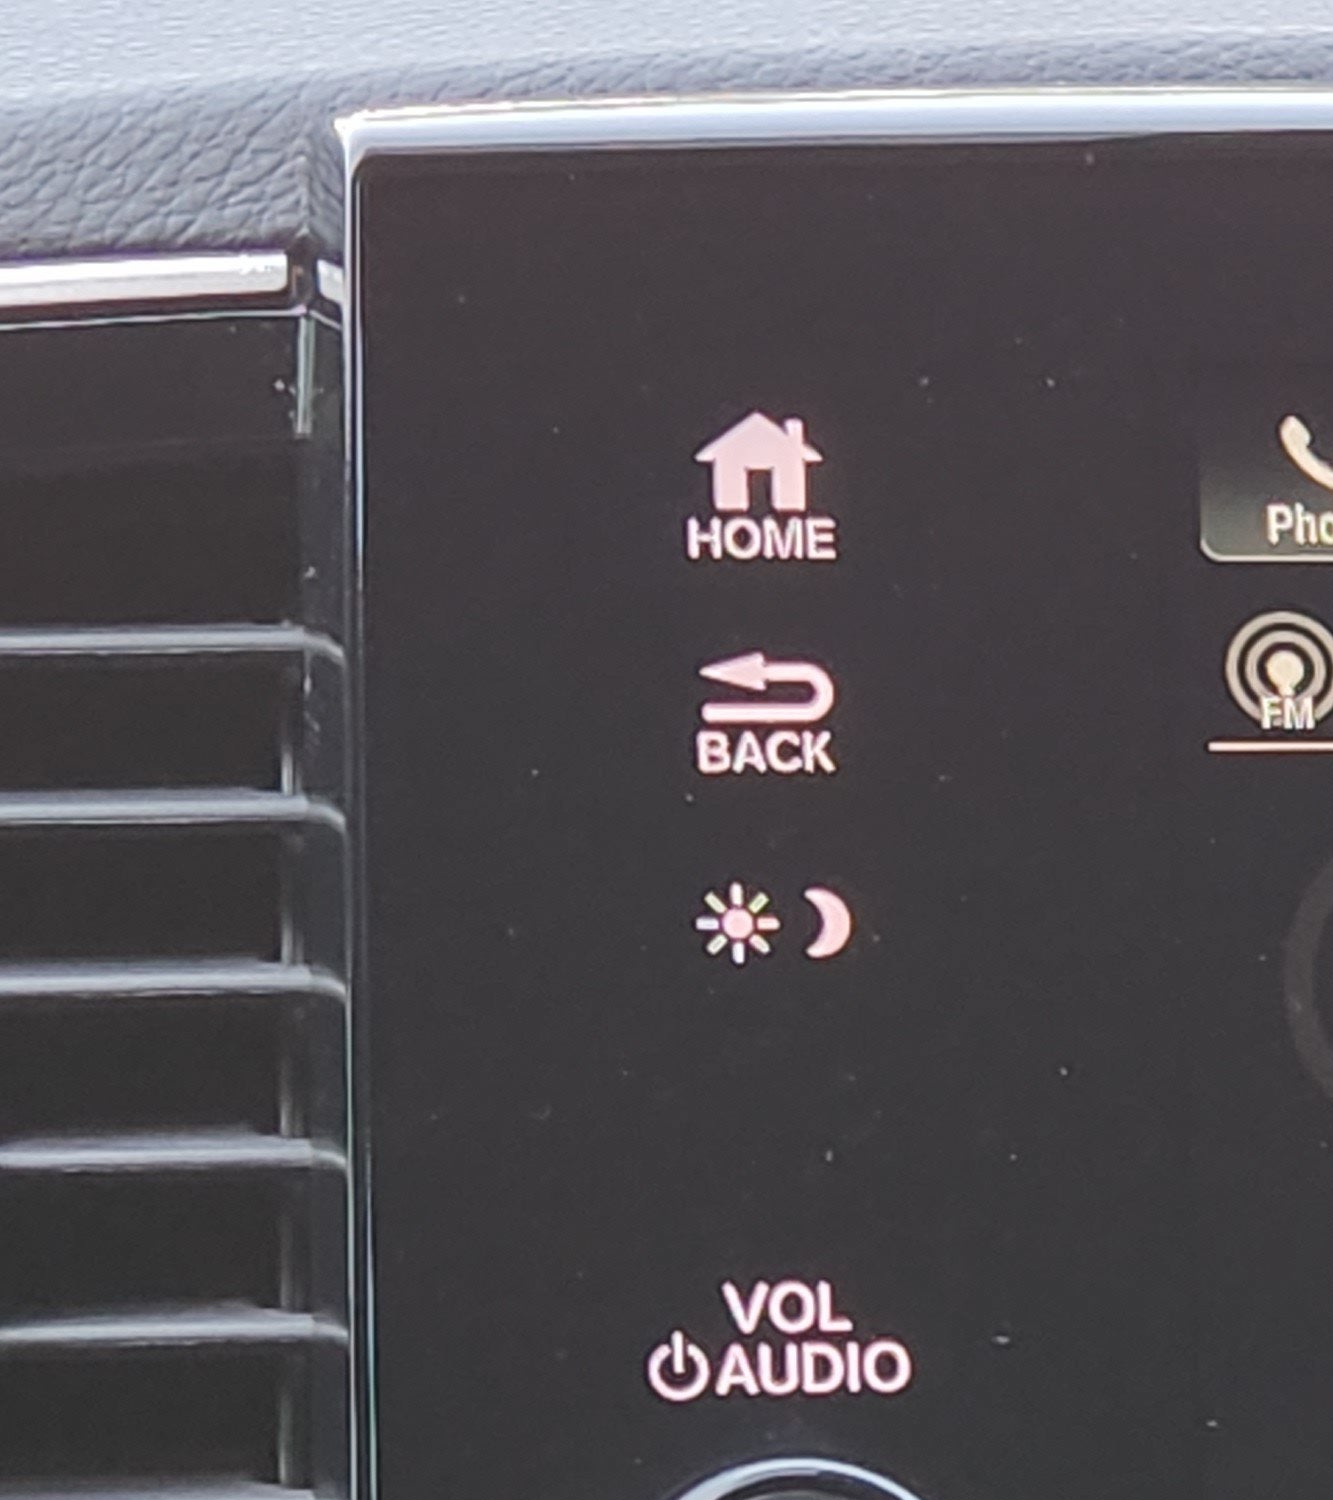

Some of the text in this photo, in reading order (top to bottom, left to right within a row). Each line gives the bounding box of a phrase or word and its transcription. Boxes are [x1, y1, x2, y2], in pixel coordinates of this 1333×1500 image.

[687, 517, 837, 560] HOME
[1260, 697, 1316, 730] FM
[696, 731, 836, 774] BACK
[721, 1280, 853, 1334] VOL
[714, 1340, 911, 1395] AUDIO
